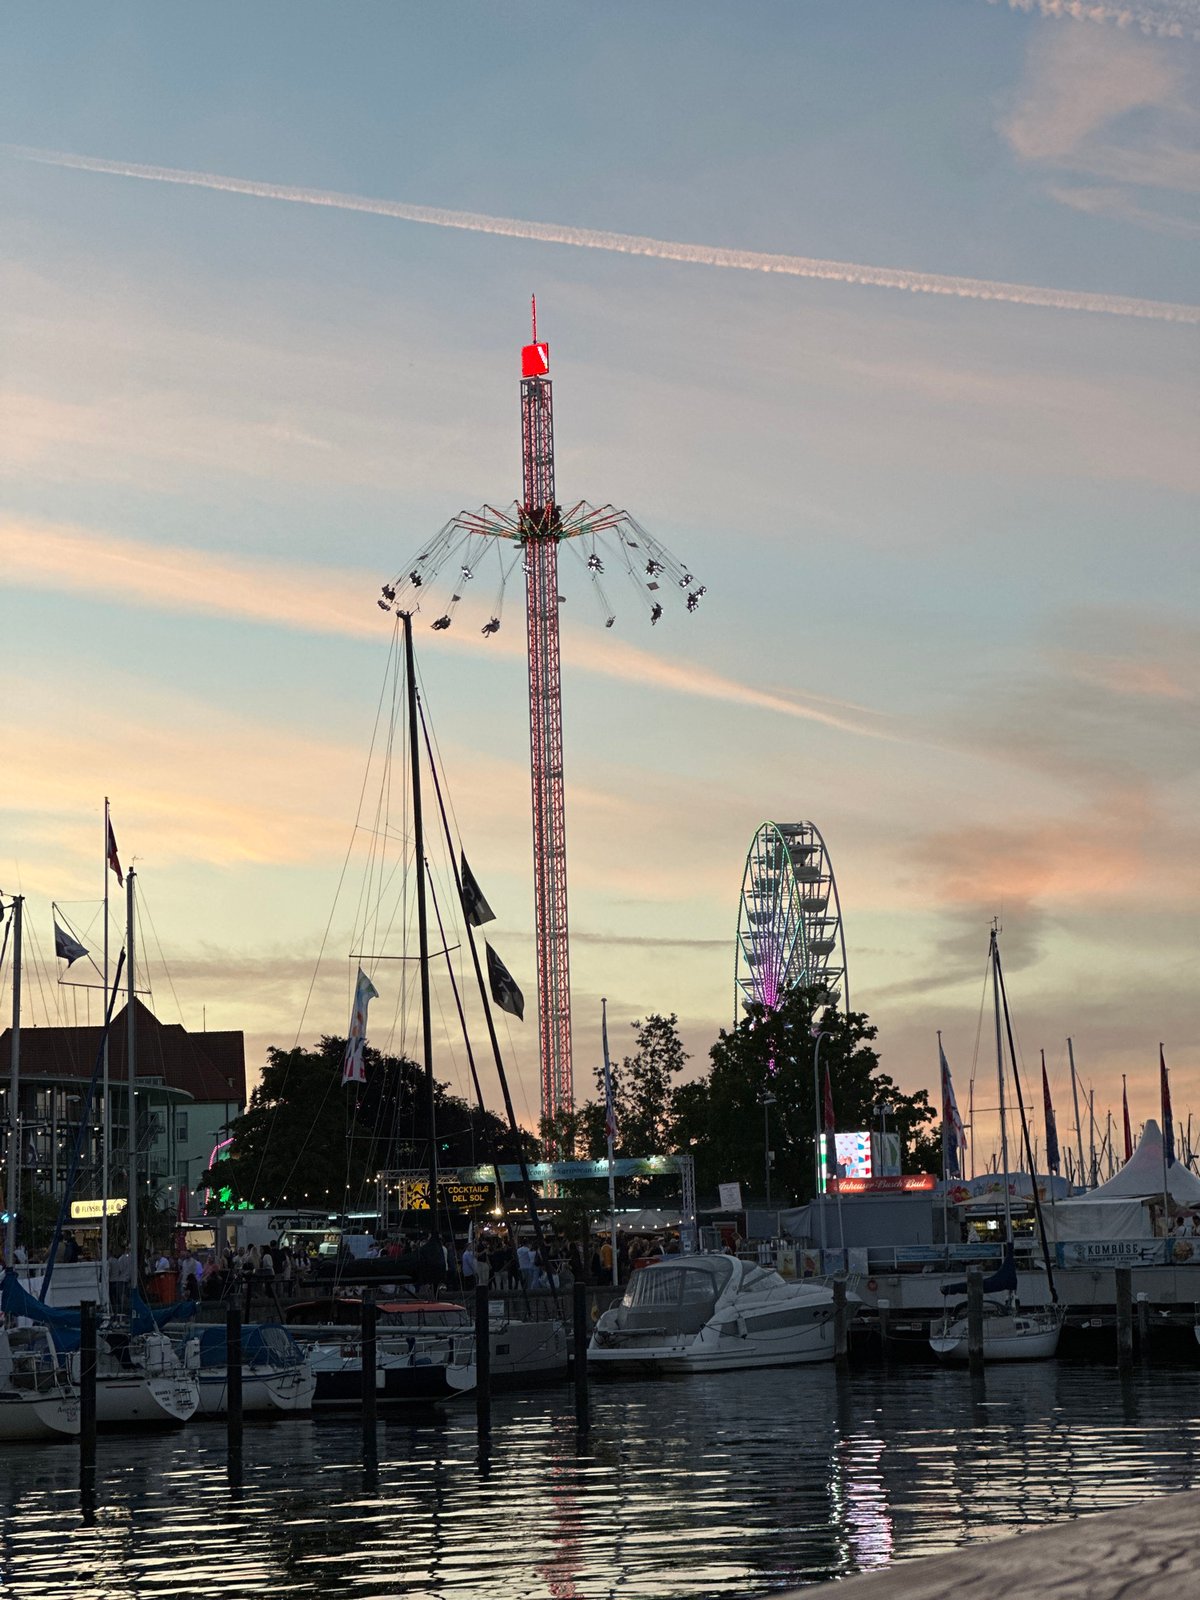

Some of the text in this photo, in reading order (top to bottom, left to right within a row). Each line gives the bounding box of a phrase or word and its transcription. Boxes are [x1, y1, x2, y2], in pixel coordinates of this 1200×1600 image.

[904, 1178, 926, 1189] Bud
[448, 1185, 489, 1194] COCKTAILS
[469, 1194, 485, 1202] SOL
[1088, 1243, 1138, 1255] KOMBÜSE
